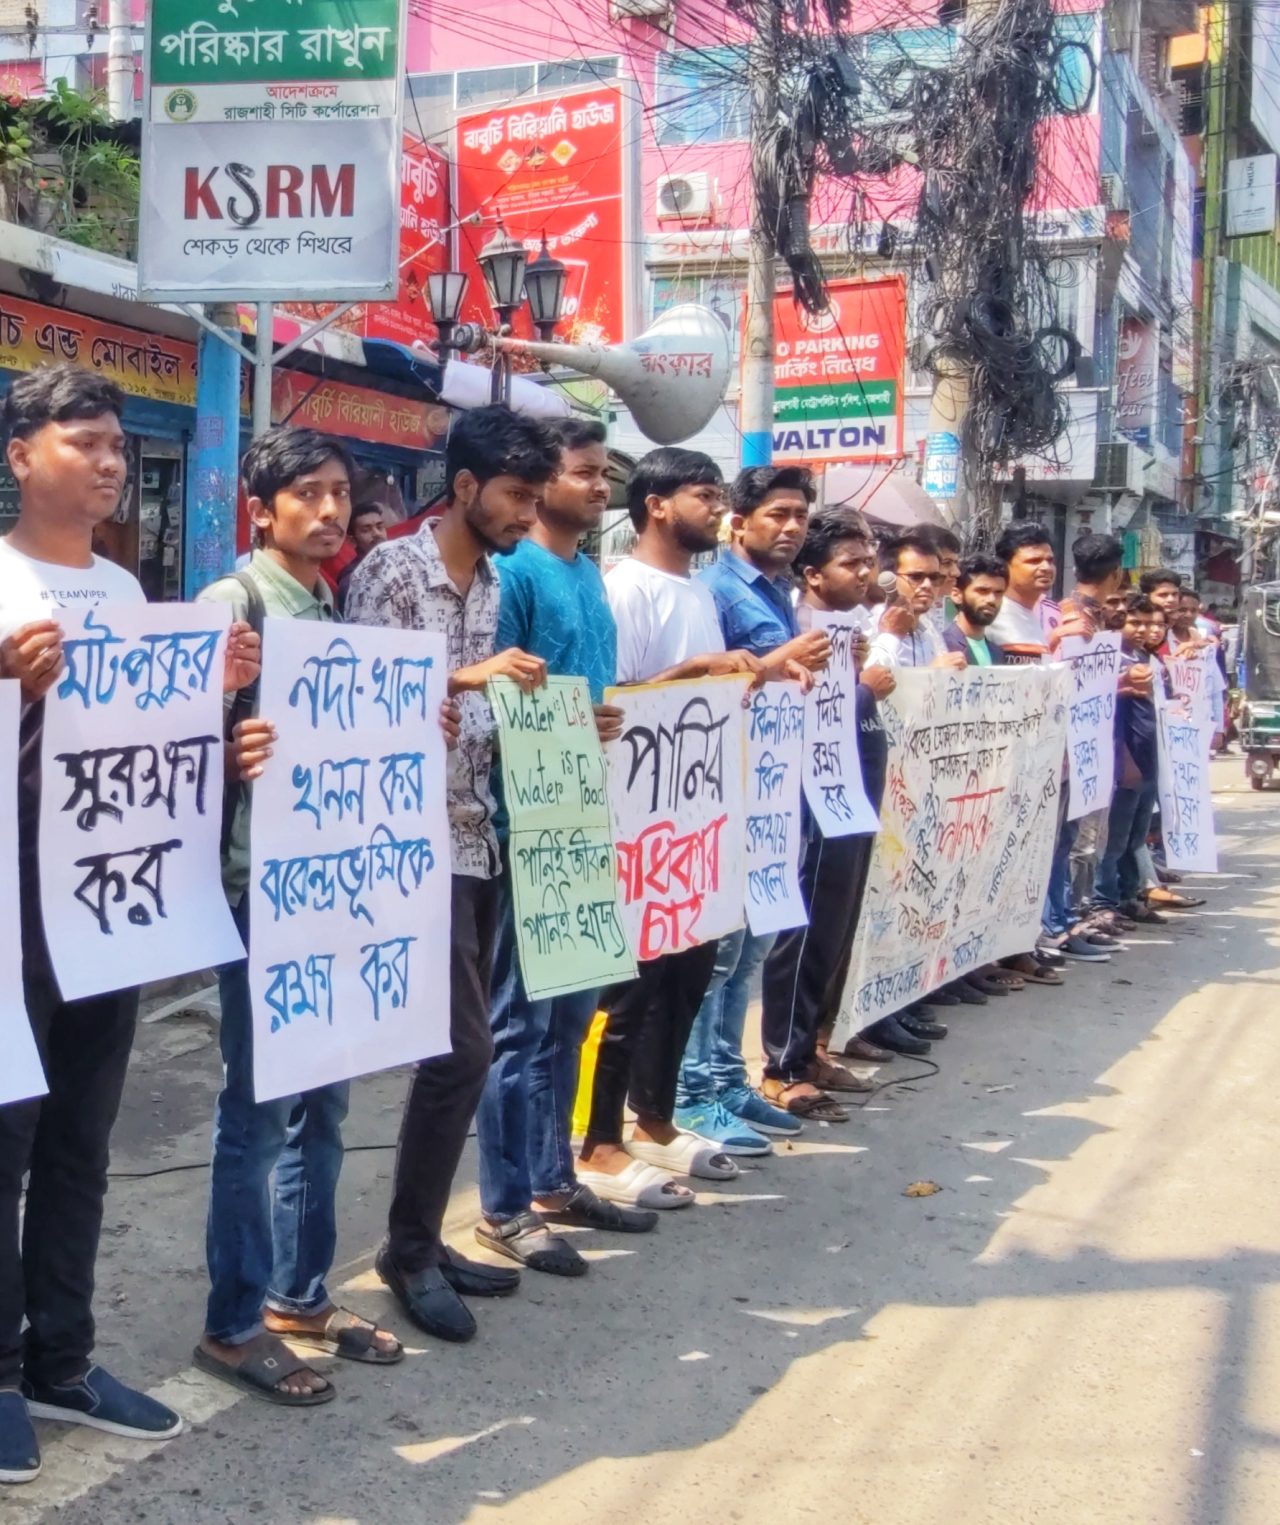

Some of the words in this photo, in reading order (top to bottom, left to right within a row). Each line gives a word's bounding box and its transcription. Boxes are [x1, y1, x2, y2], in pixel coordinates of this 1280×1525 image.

[160, 21, 288, 66] পরিষ্কার
[297, 23, 391, 70] রাখুন
[224, 104, 275, 120] রাজশাহী
[280, 102, 307, 118] সিটি
[312, 101, 379, 118] কর্পোরেশন
[266, 84, 339, 98] আদেশক্রমে
[571, 101, 615, 130] হাউজ
[184, 162, 356, 226] KSRM
[183, 236, 238, 258] শেকড়
[246, 236, 290, 255] থেকে
[297, 230, 352, 254] শিখরে
[91, 337, 181, 385] মোবাইল
[774, 356, 817, 380] ার্কিং
[821, 354, 877, 376] নিষেধ
[795, 333, 880, 355] PARKING
[389, 409, 421, 433] হাউজ
[501, 690, 554, 732] Water
[560, 687, 588, 728] Life
[621, 697, 729, 813] পানির
[755, 751, 788, 800] বিল
[54, 735, 219, 832] সুরক্ষা
[293, 757, 370, 830] খনন
[379, 751, 425, 815] কর
[511, 749, 563, 806] Water
[561, 750, 573, 775] is
[576, 754, 605, 812] Food
[820, 784, 854, 822] কর
[568, 829, 611, 882] জীবন
[73, 839, 182, 935] কর
[265, 953, 336, 1034] রক্ষা
[361, 937, 417, 1022] কর
